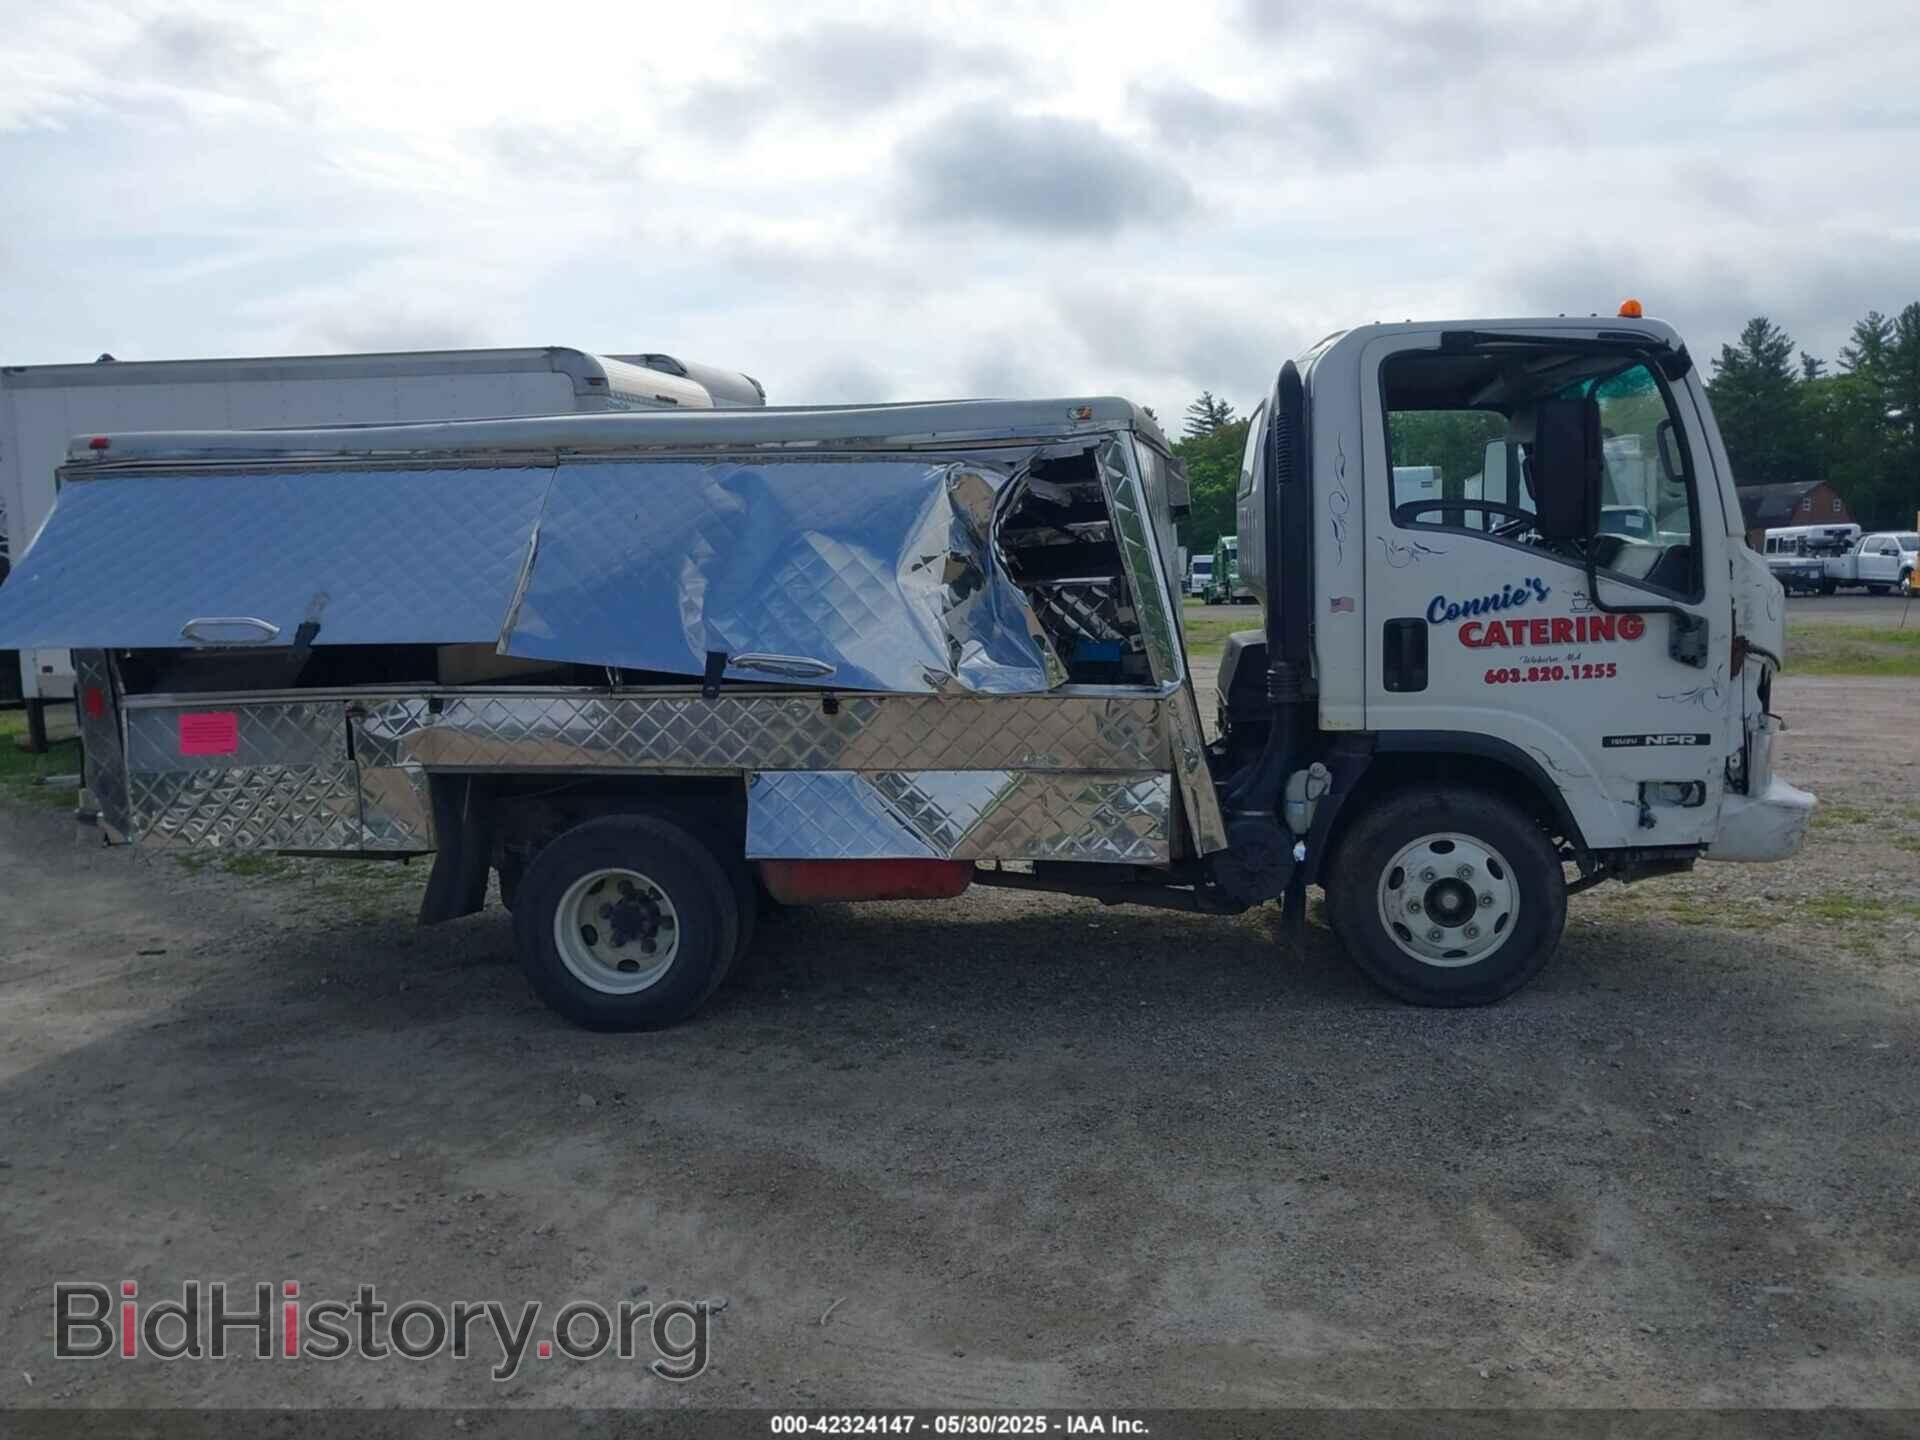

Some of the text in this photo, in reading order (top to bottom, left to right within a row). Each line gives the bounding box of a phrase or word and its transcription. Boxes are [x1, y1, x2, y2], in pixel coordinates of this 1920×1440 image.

[1427, 577, 1551, 624] Connie's
[1458, 614, 1646, 648] CATERING
[1484, 662, 1618, 685] 603.820.1255
[1645, 735, 1697, 745] NPR
